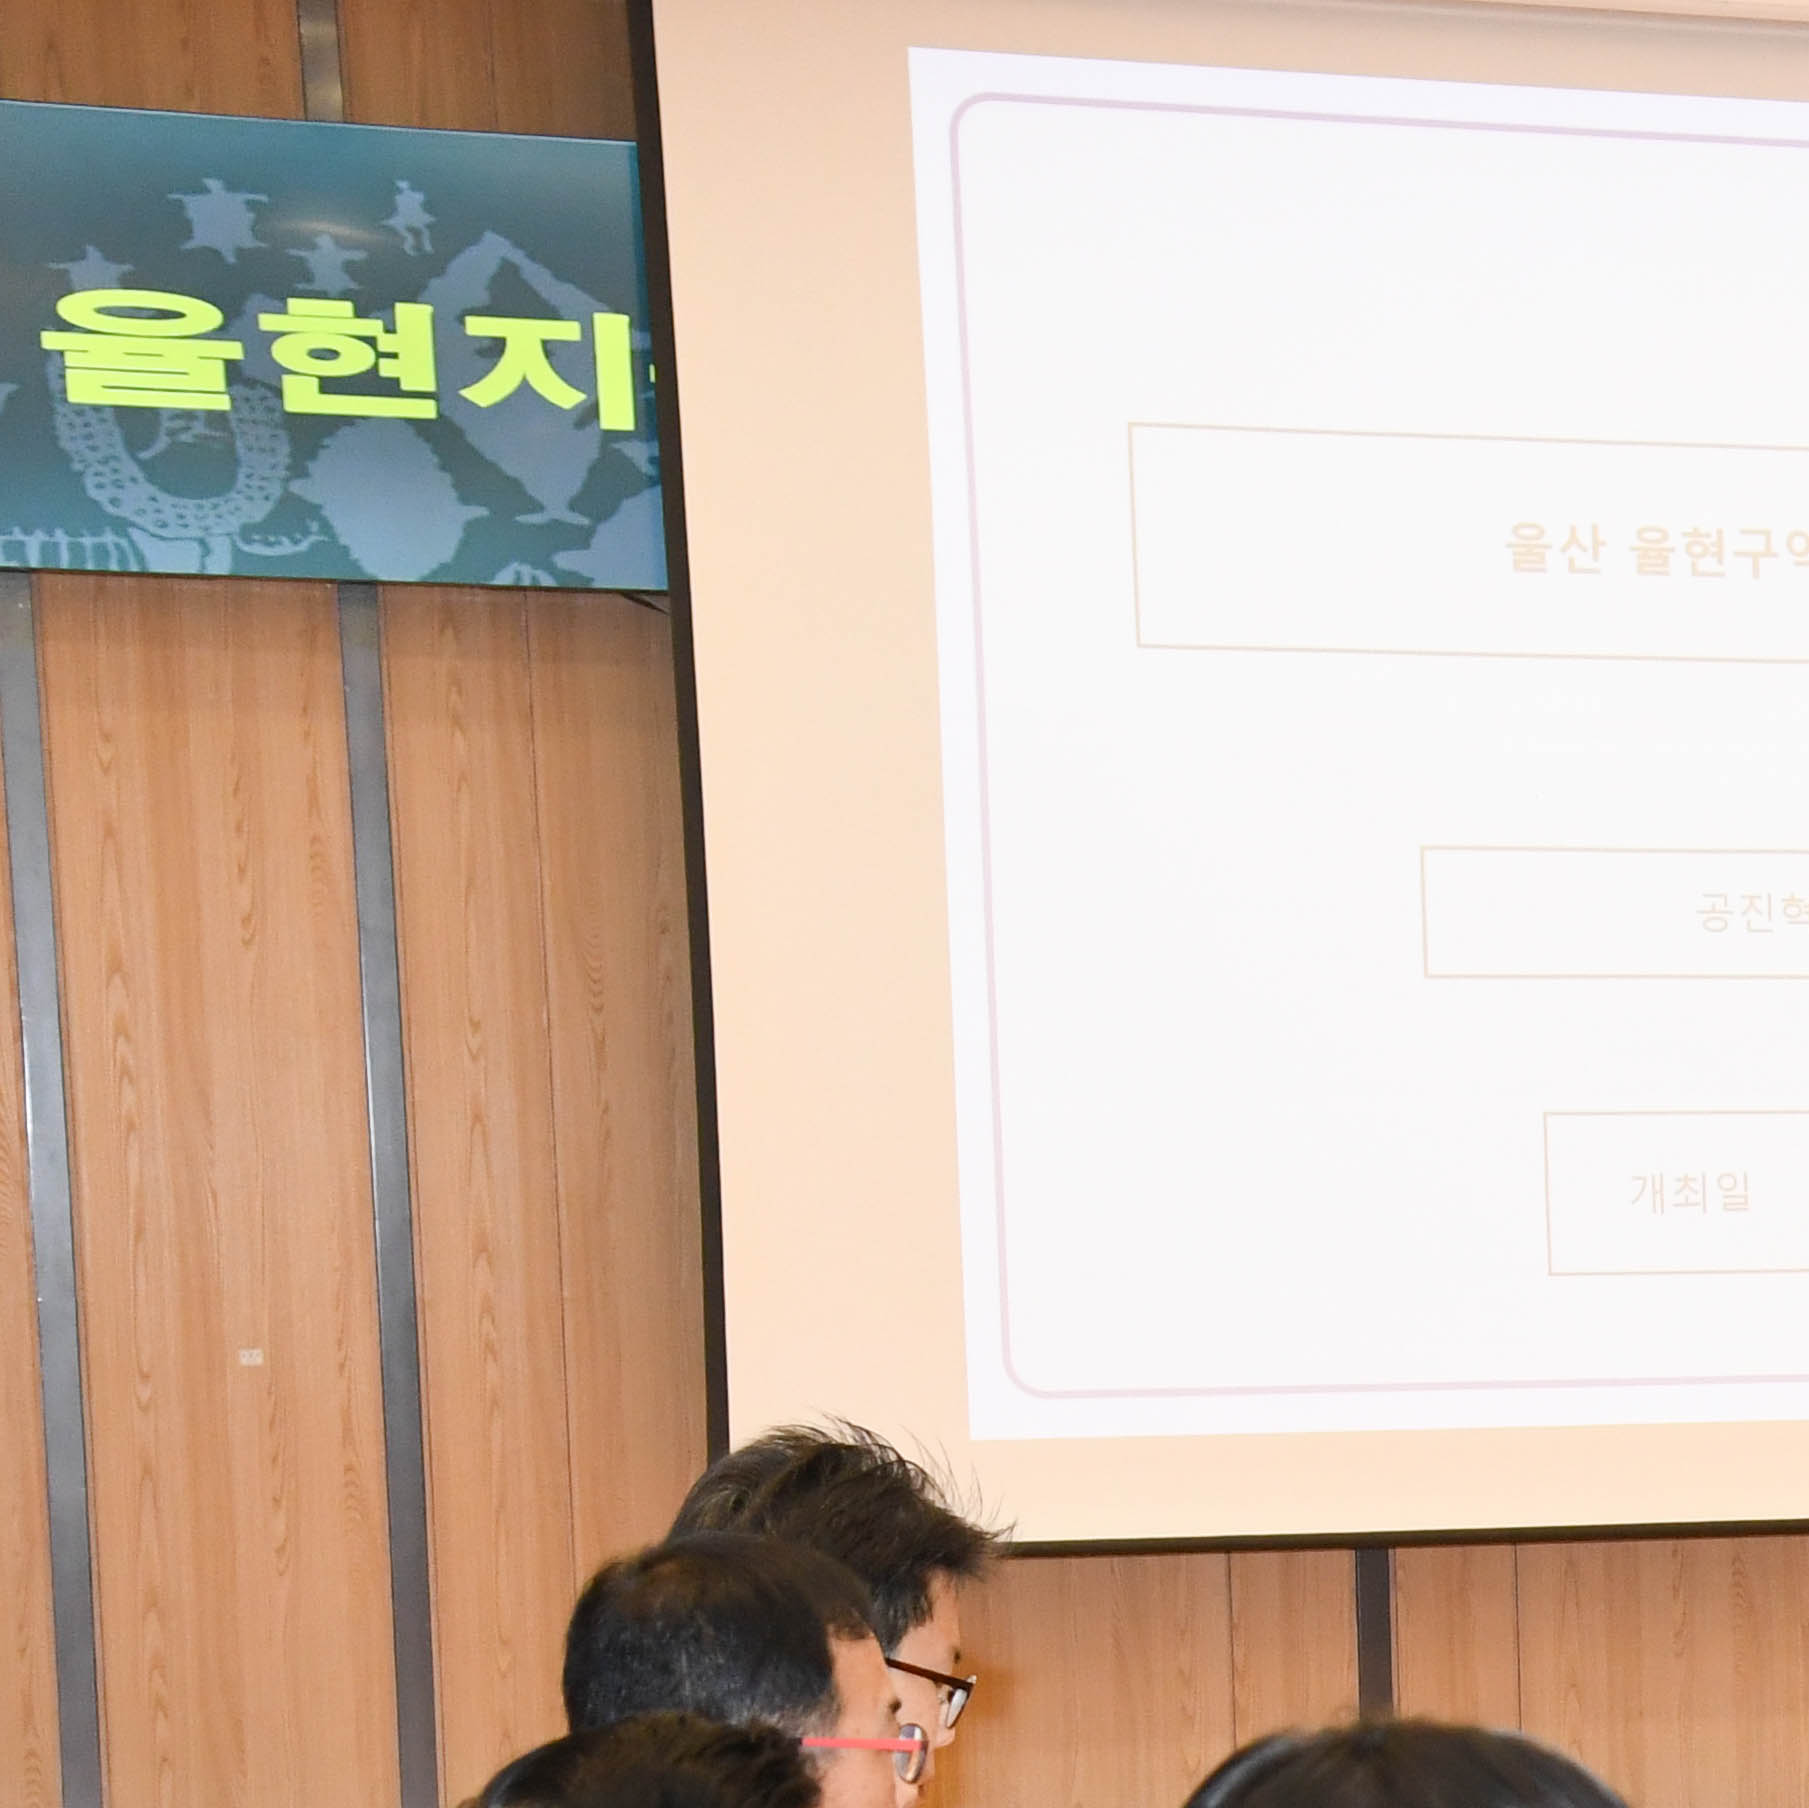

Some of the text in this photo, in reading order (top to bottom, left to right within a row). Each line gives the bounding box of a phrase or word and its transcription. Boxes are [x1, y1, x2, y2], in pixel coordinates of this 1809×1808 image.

[40, 288, 656, 431] 율현지
[1504, 521, 1607, 575] 울산
[1630, 1171, 1751, 1216] 개최일
